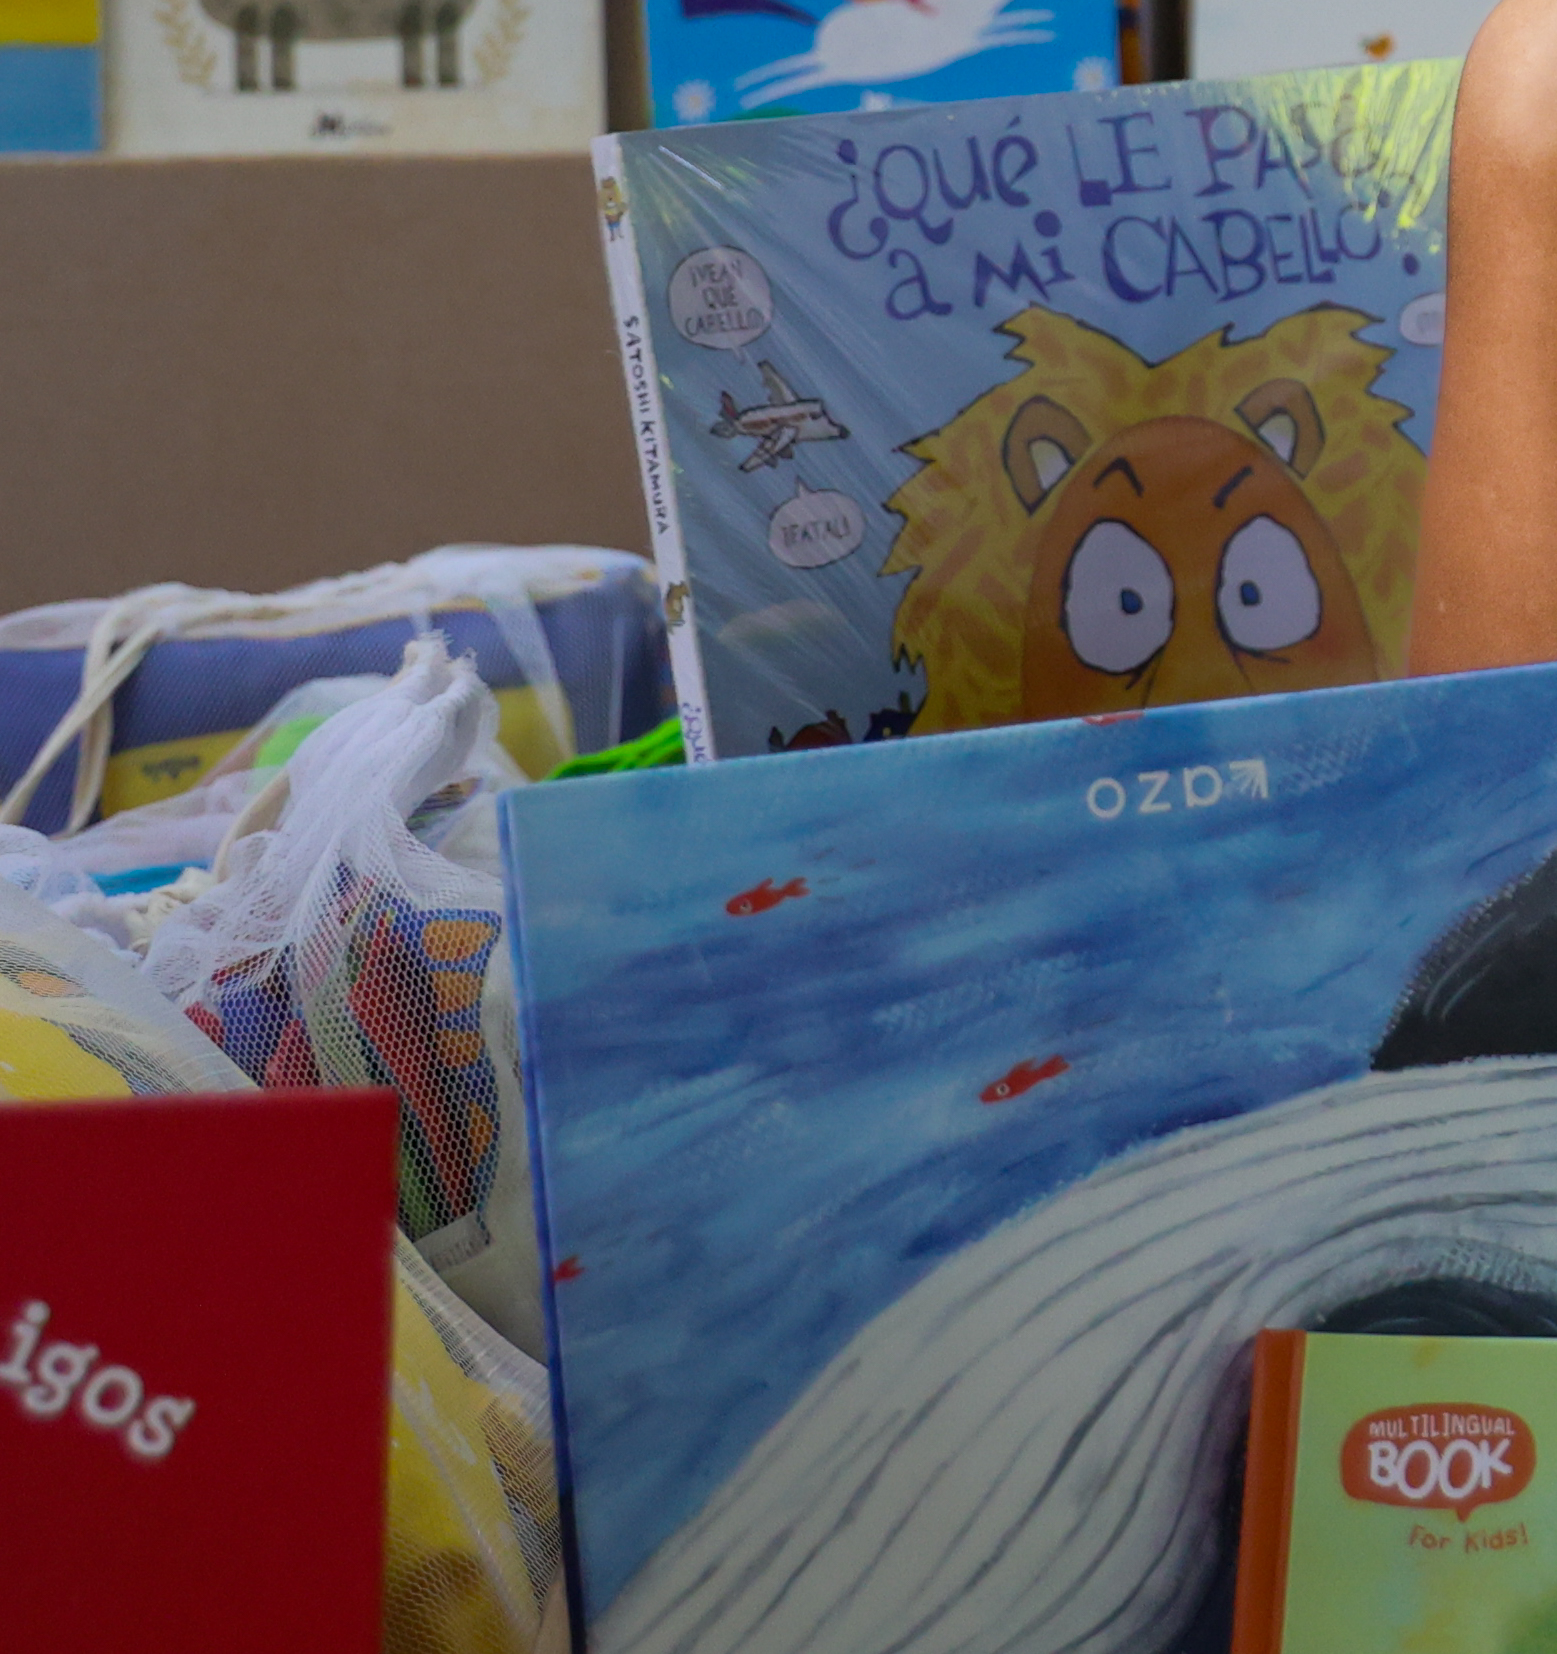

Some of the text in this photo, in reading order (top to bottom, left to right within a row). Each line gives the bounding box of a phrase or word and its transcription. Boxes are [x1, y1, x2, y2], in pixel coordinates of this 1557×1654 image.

[1066, 111, 1175, 208] LE
[621, 315, 671, 536] SATOSHI KITAMURA
[0, 1299, 197, 1459] igos
[1369, 1412, 1516, 1438] MULTILINGUAL
[1368, 1438, 1513, 1499] BOOK
[1408, 1523, 1452, 1551] For
